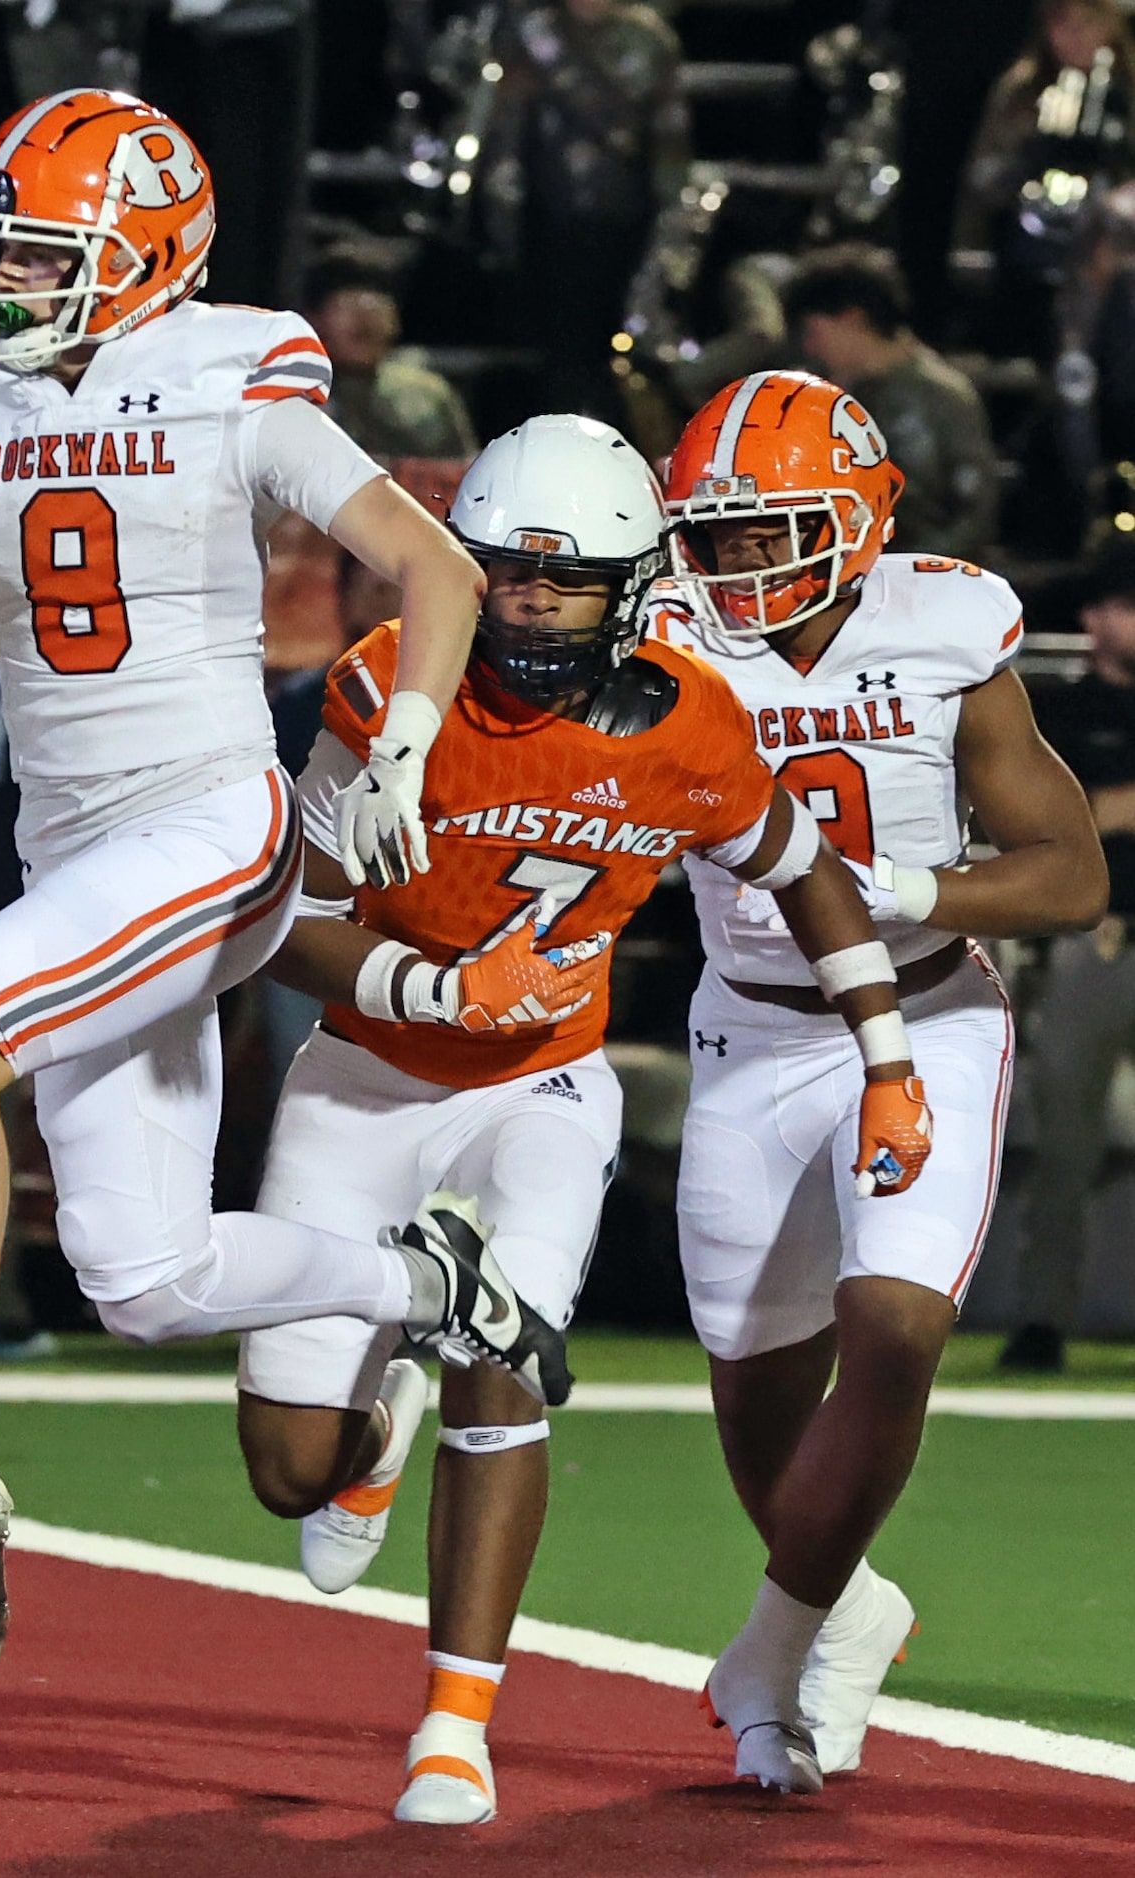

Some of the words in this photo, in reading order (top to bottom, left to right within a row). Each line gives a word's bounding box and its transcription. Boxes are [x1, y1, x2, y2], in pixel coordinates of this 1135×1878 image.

[105, 123, 204, 209] R
[19, 487, 132, 675] 8
[432, 804, 696, 857] MUSTANGS
[571, 792, 628, 810] adidas
[453, 851, 609, 968] 7
[531, 1087, 583, 1103] adidas
